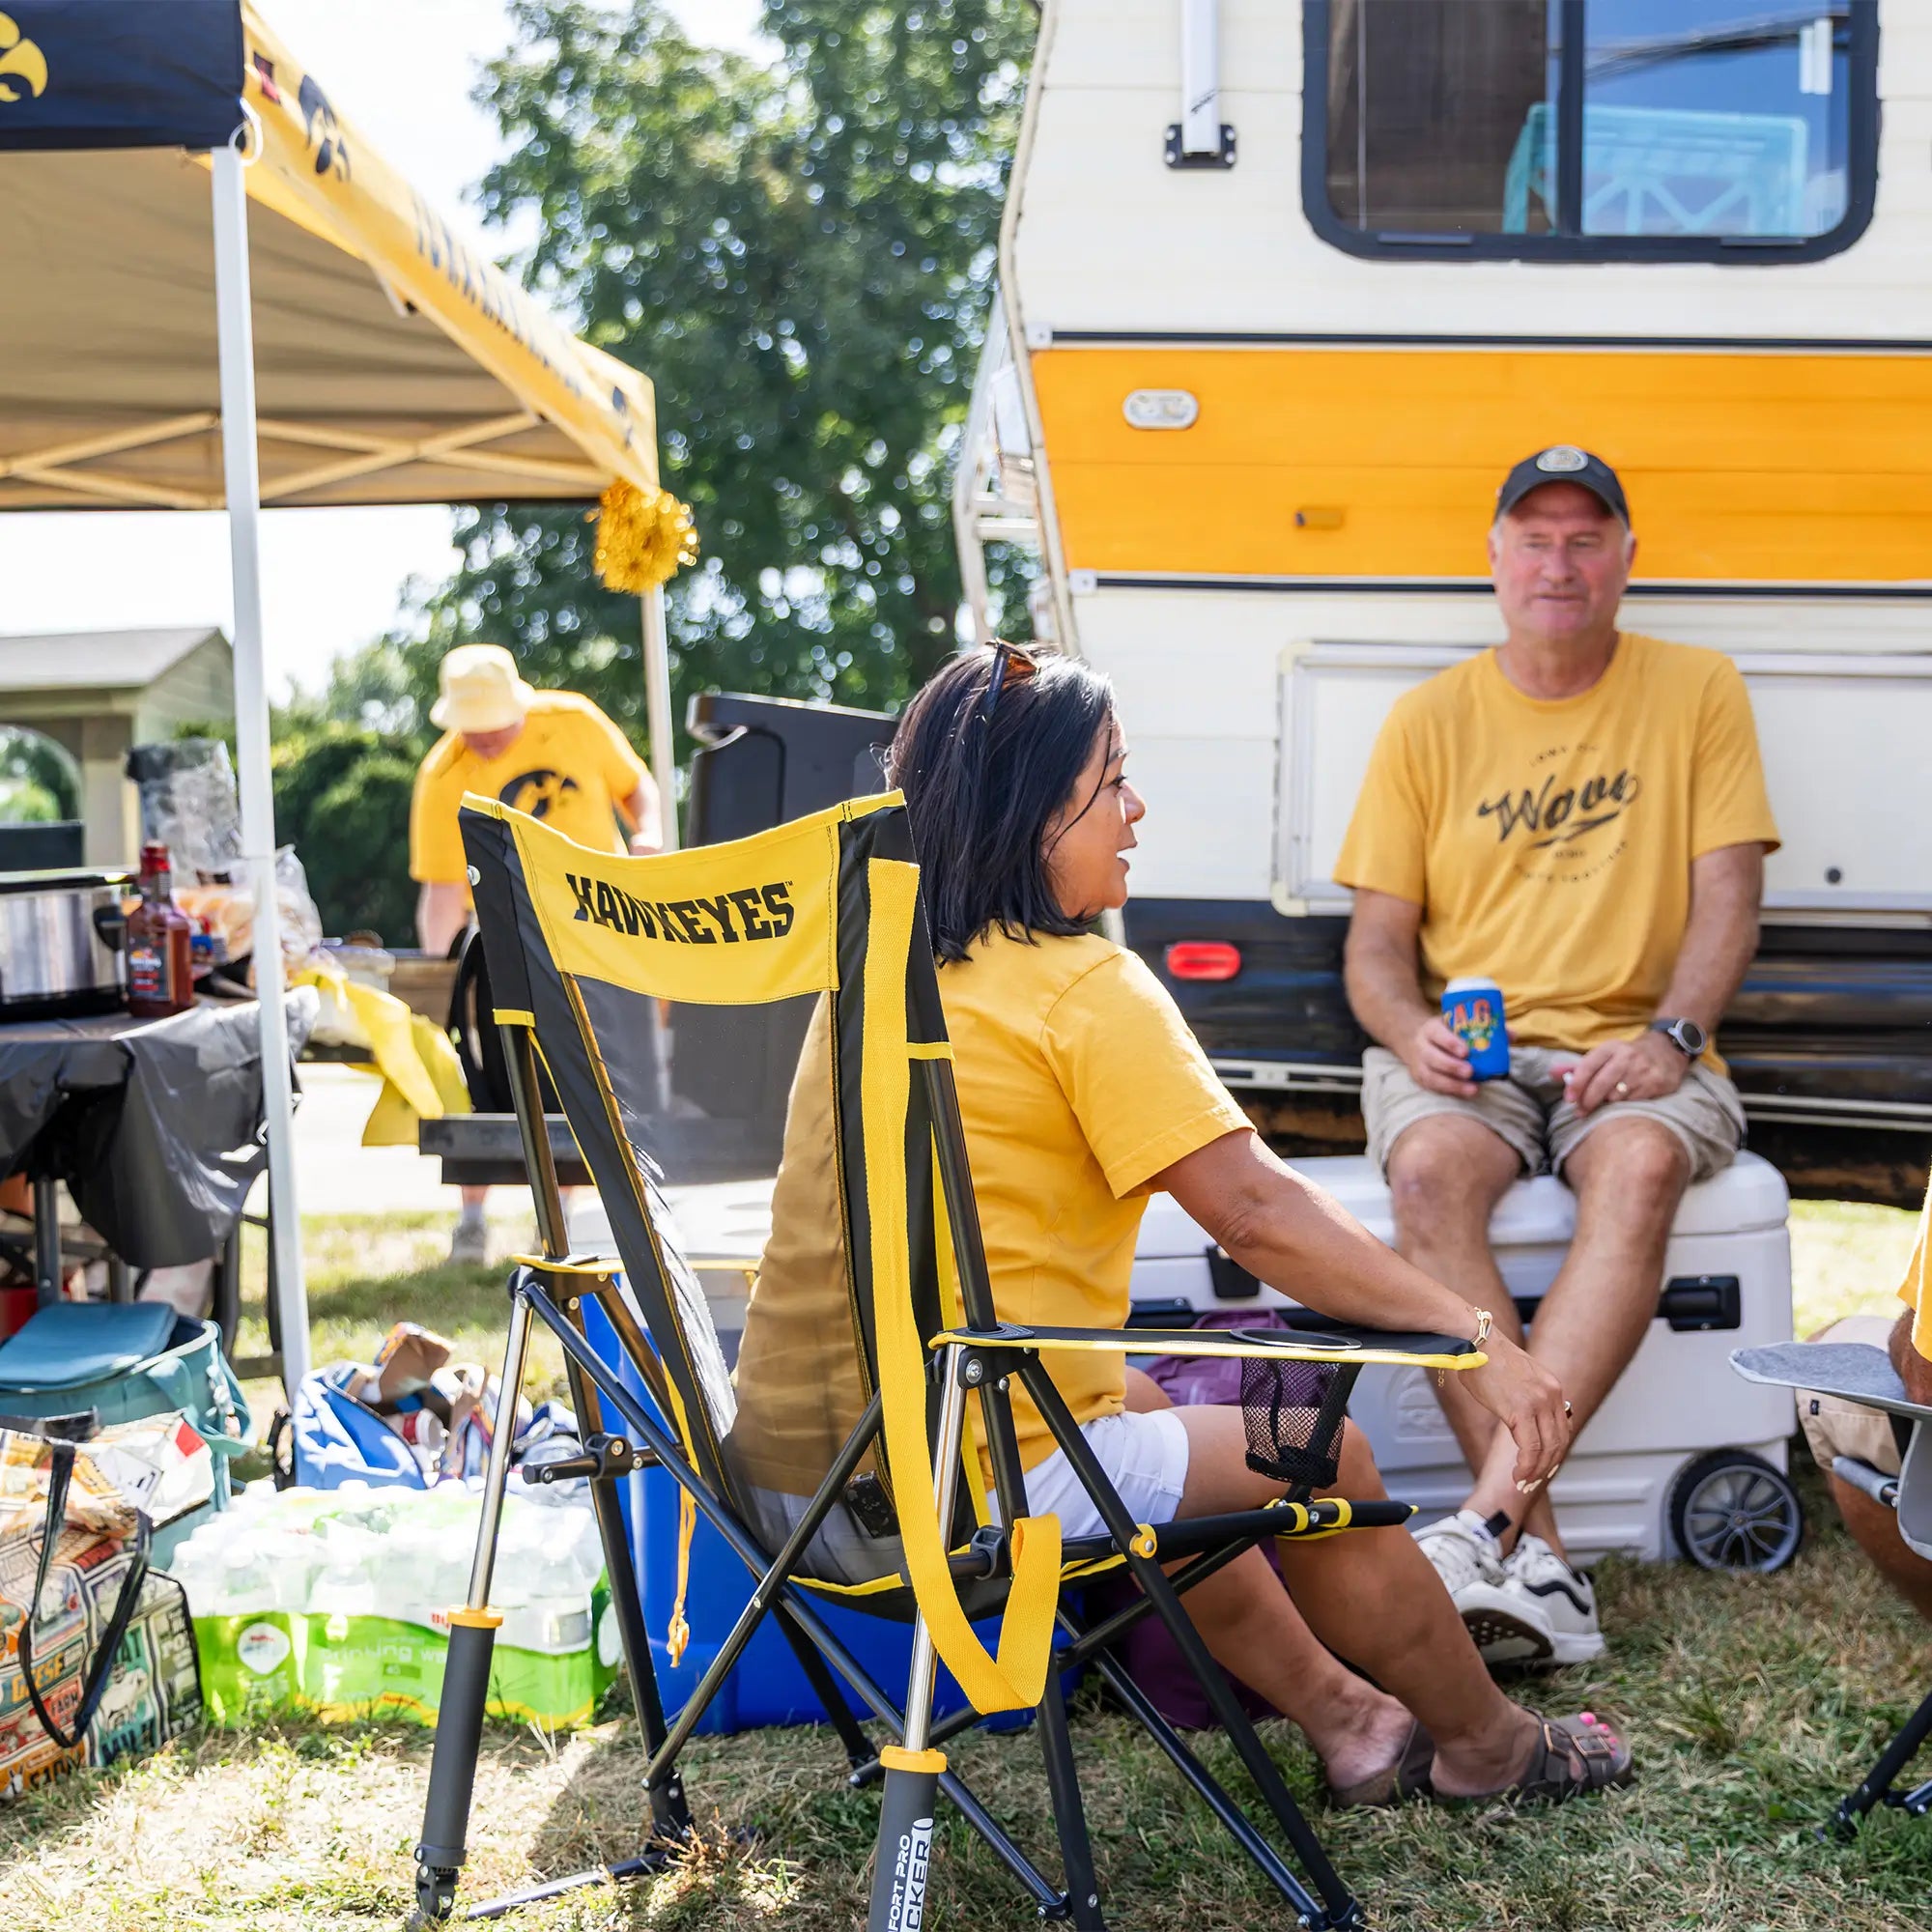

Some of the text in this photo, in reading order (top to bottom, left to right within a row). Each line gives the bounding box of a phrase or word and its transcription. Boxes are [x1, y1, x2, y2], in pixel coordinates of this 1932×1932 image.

[565, 872, 794, 945] HAWKEYES
[888, 1834, 911, 1932] FORT PRO
